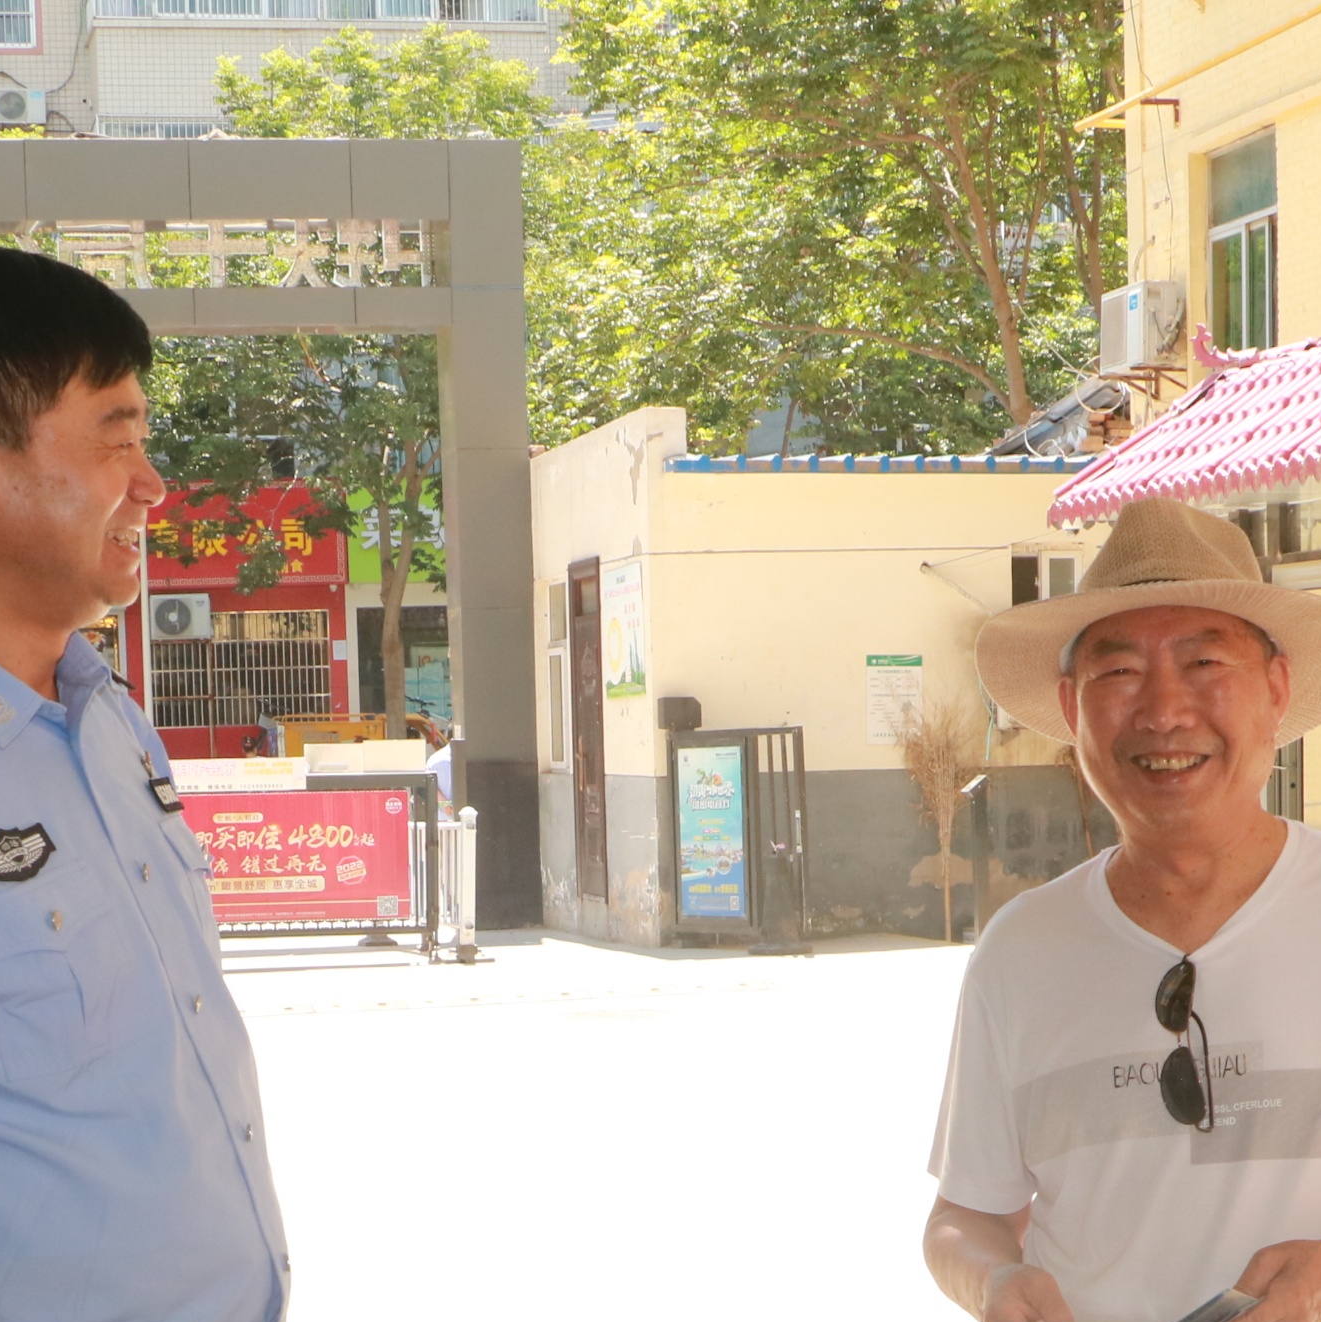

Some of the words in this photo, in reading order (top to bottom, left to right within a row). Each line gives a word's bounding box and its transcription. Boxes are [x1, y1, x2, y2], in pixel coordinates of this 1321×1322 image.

[171, 761, 237, 778] 月子会所
[240, 854, 328, 875] 错过再无
[336, 859, 365, 875] 2022
[221, 880, 267, 891] 瞰景舒居
[272, 878, 319, 890] 惠享全城
